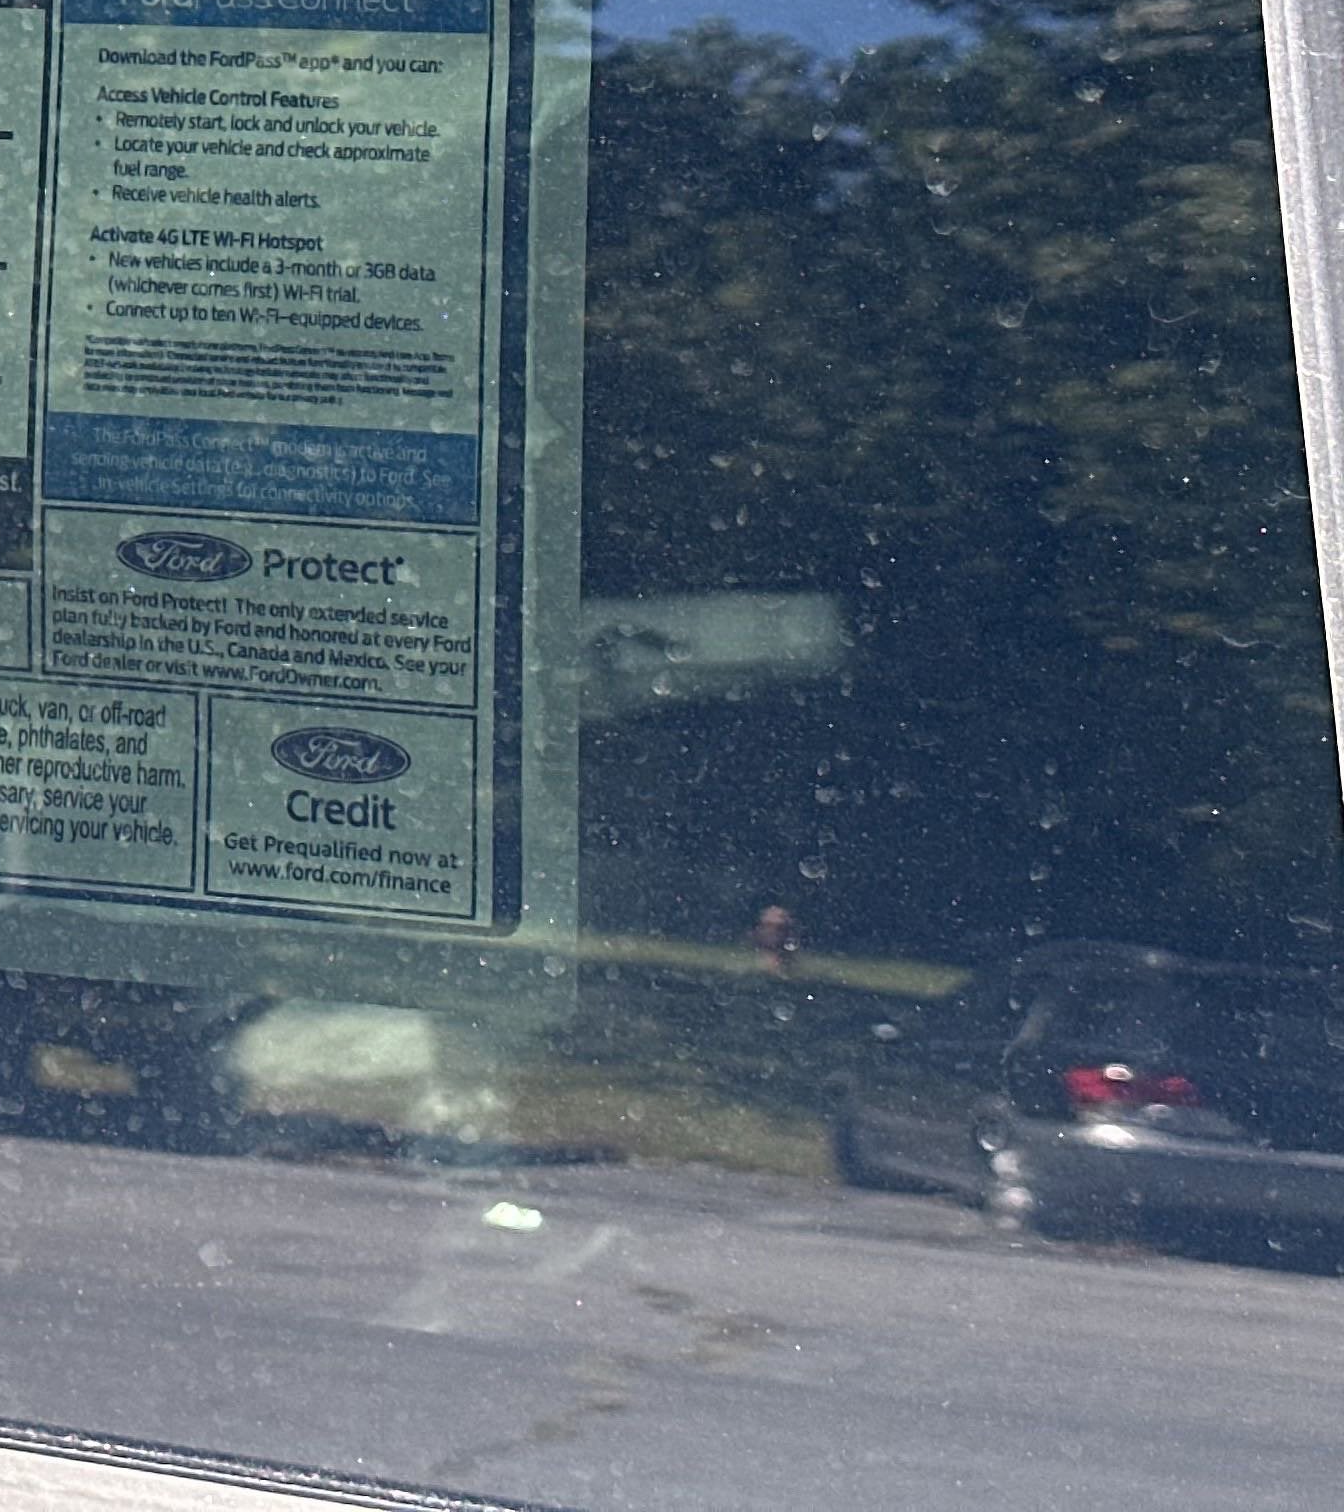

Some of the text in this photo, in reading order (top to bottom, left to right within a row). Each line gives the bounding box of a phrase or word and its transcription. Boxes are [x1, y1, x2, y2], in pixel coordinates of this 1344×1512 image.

[90, 227, 154, 245] Activate
[157, 229, 178, 246] 4G
[182, 230, 210, 247] LTE
[259, 232, 323, 253] Hotspot
[287, 789, 396, 830] Credit
[224, 833, 459, 869] Get Prequalified now at
[228, 856, 453, 895] www.ford.com/finance
